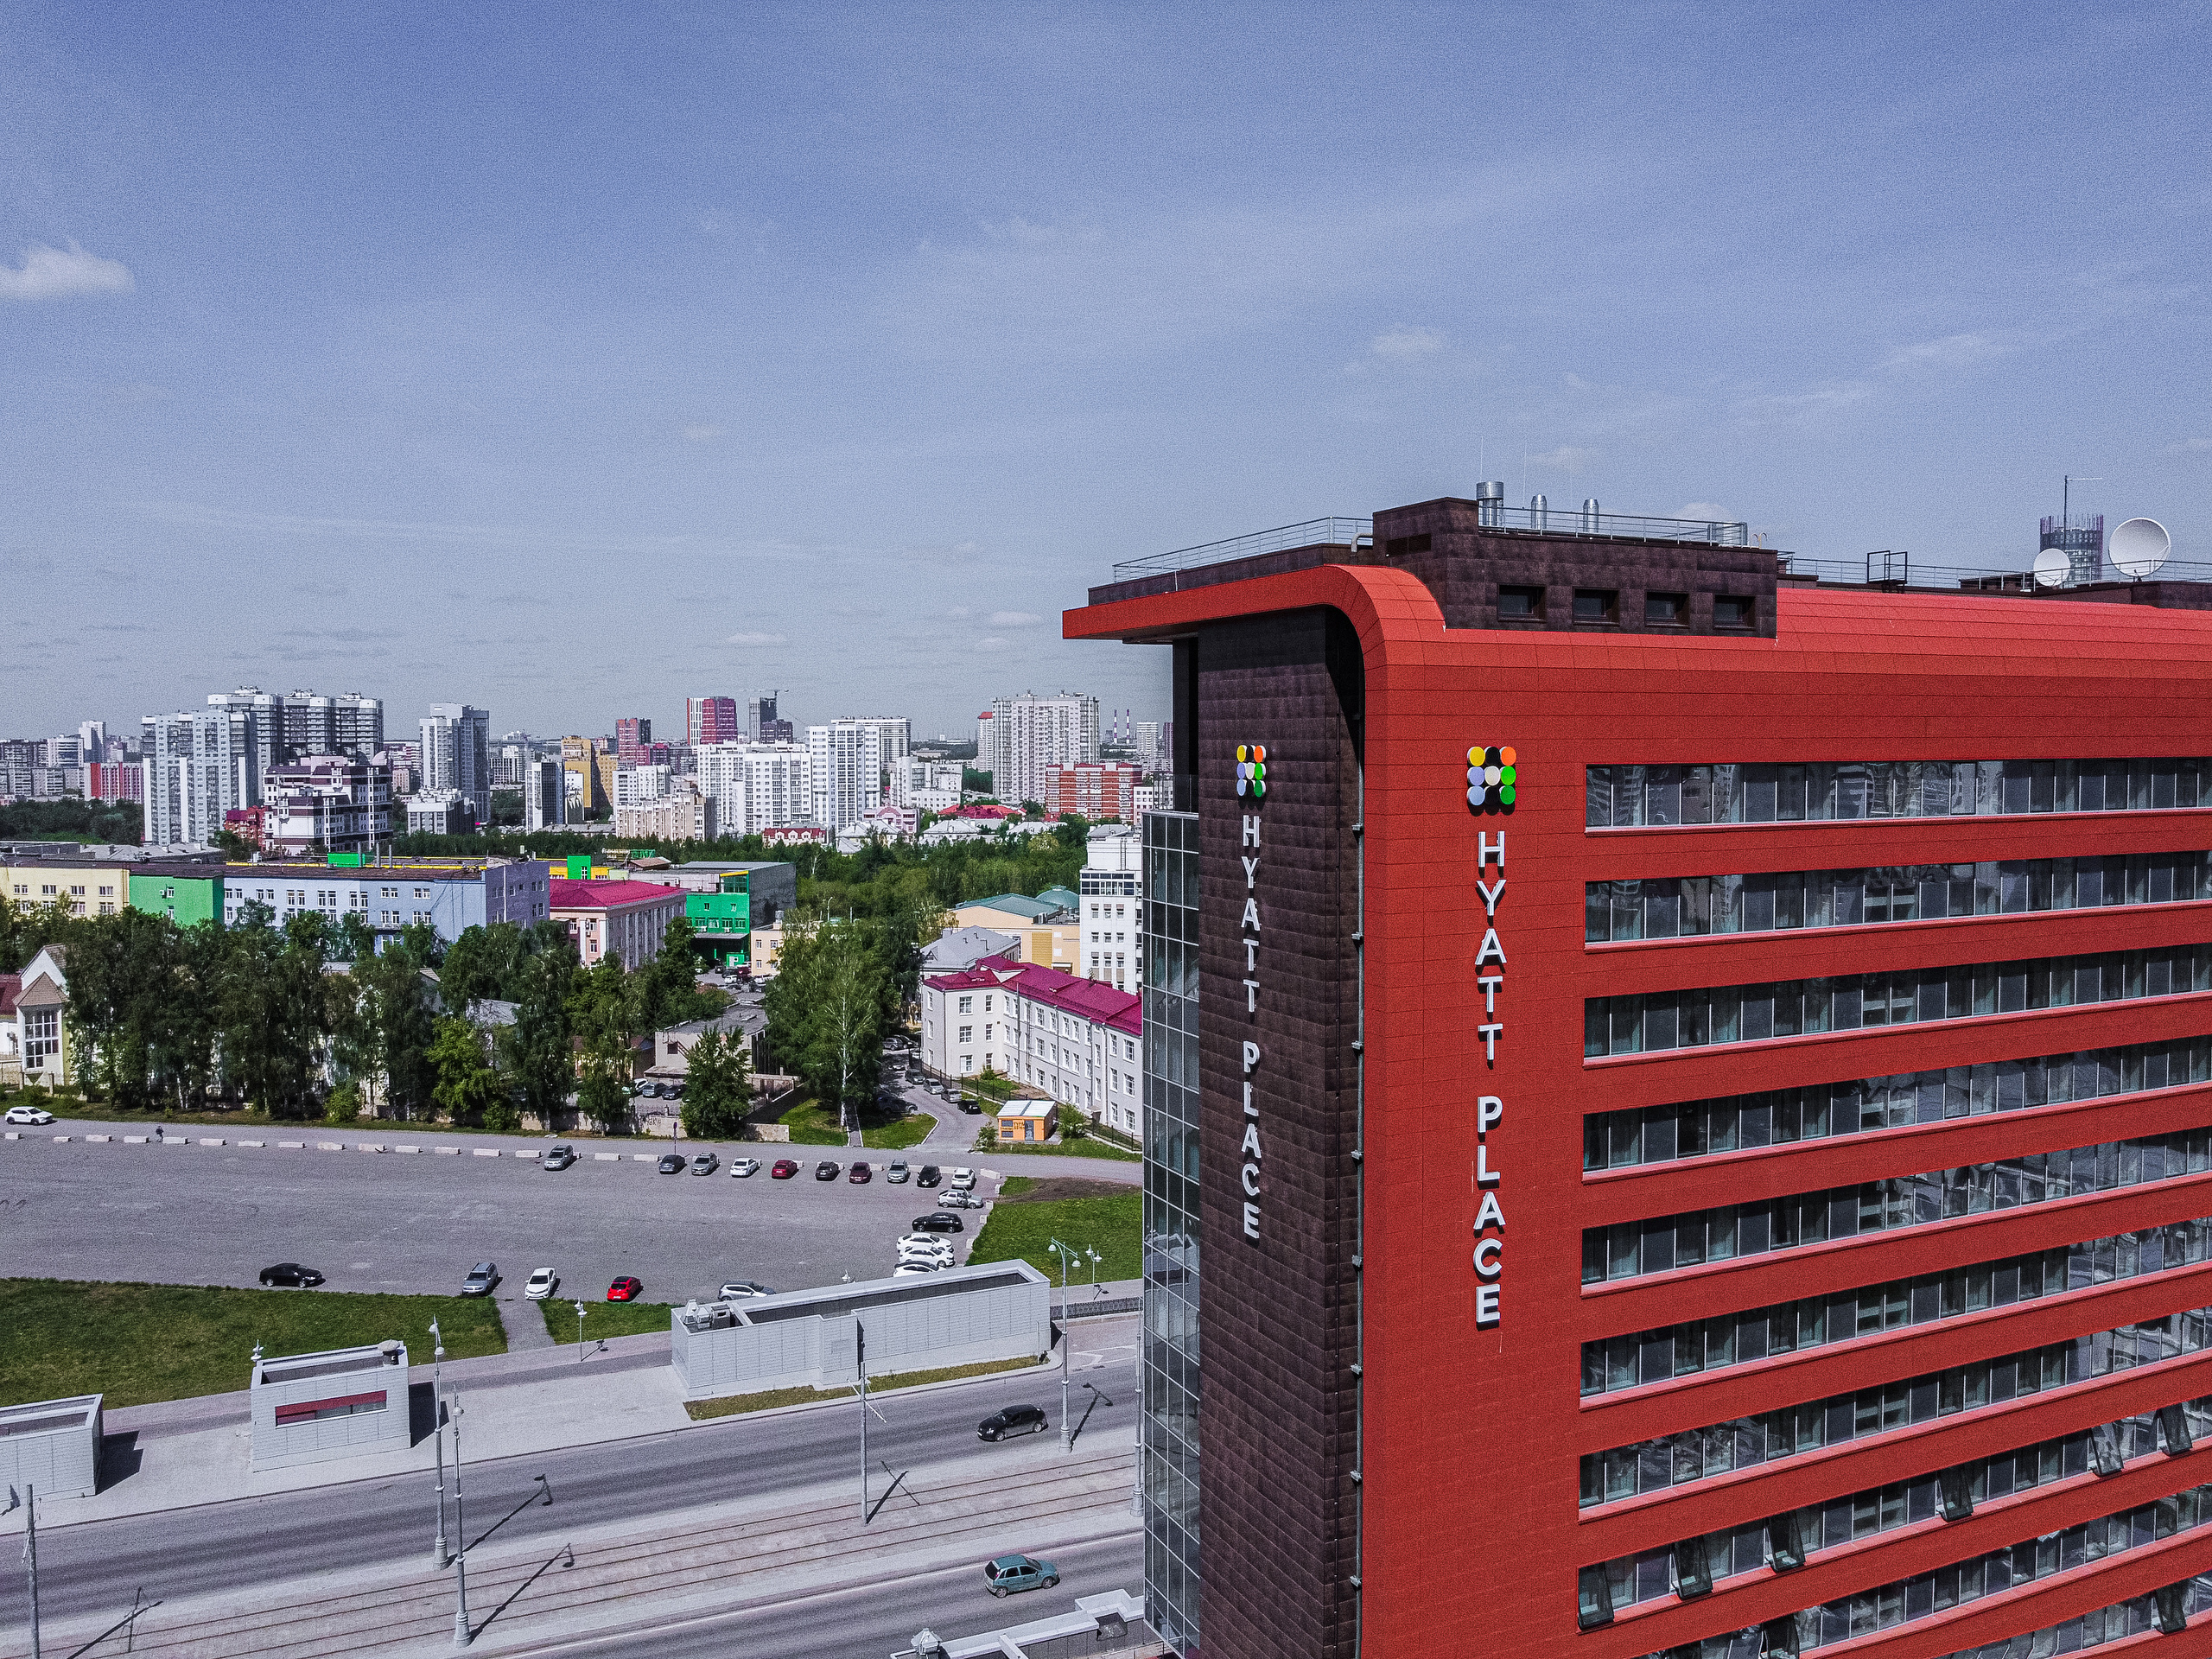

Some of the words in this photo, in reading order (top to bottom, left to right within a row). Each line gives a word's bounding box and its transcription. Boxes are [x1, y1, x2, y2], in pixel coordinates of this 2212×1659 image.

[1241, 815, 1261, 1013] HYATT
[1474, 830, 1507, 1061] HYATT
[1241, 1040, 1262, 1239] PLACE
[1472, 1096, 1506, 1324] PLACE
